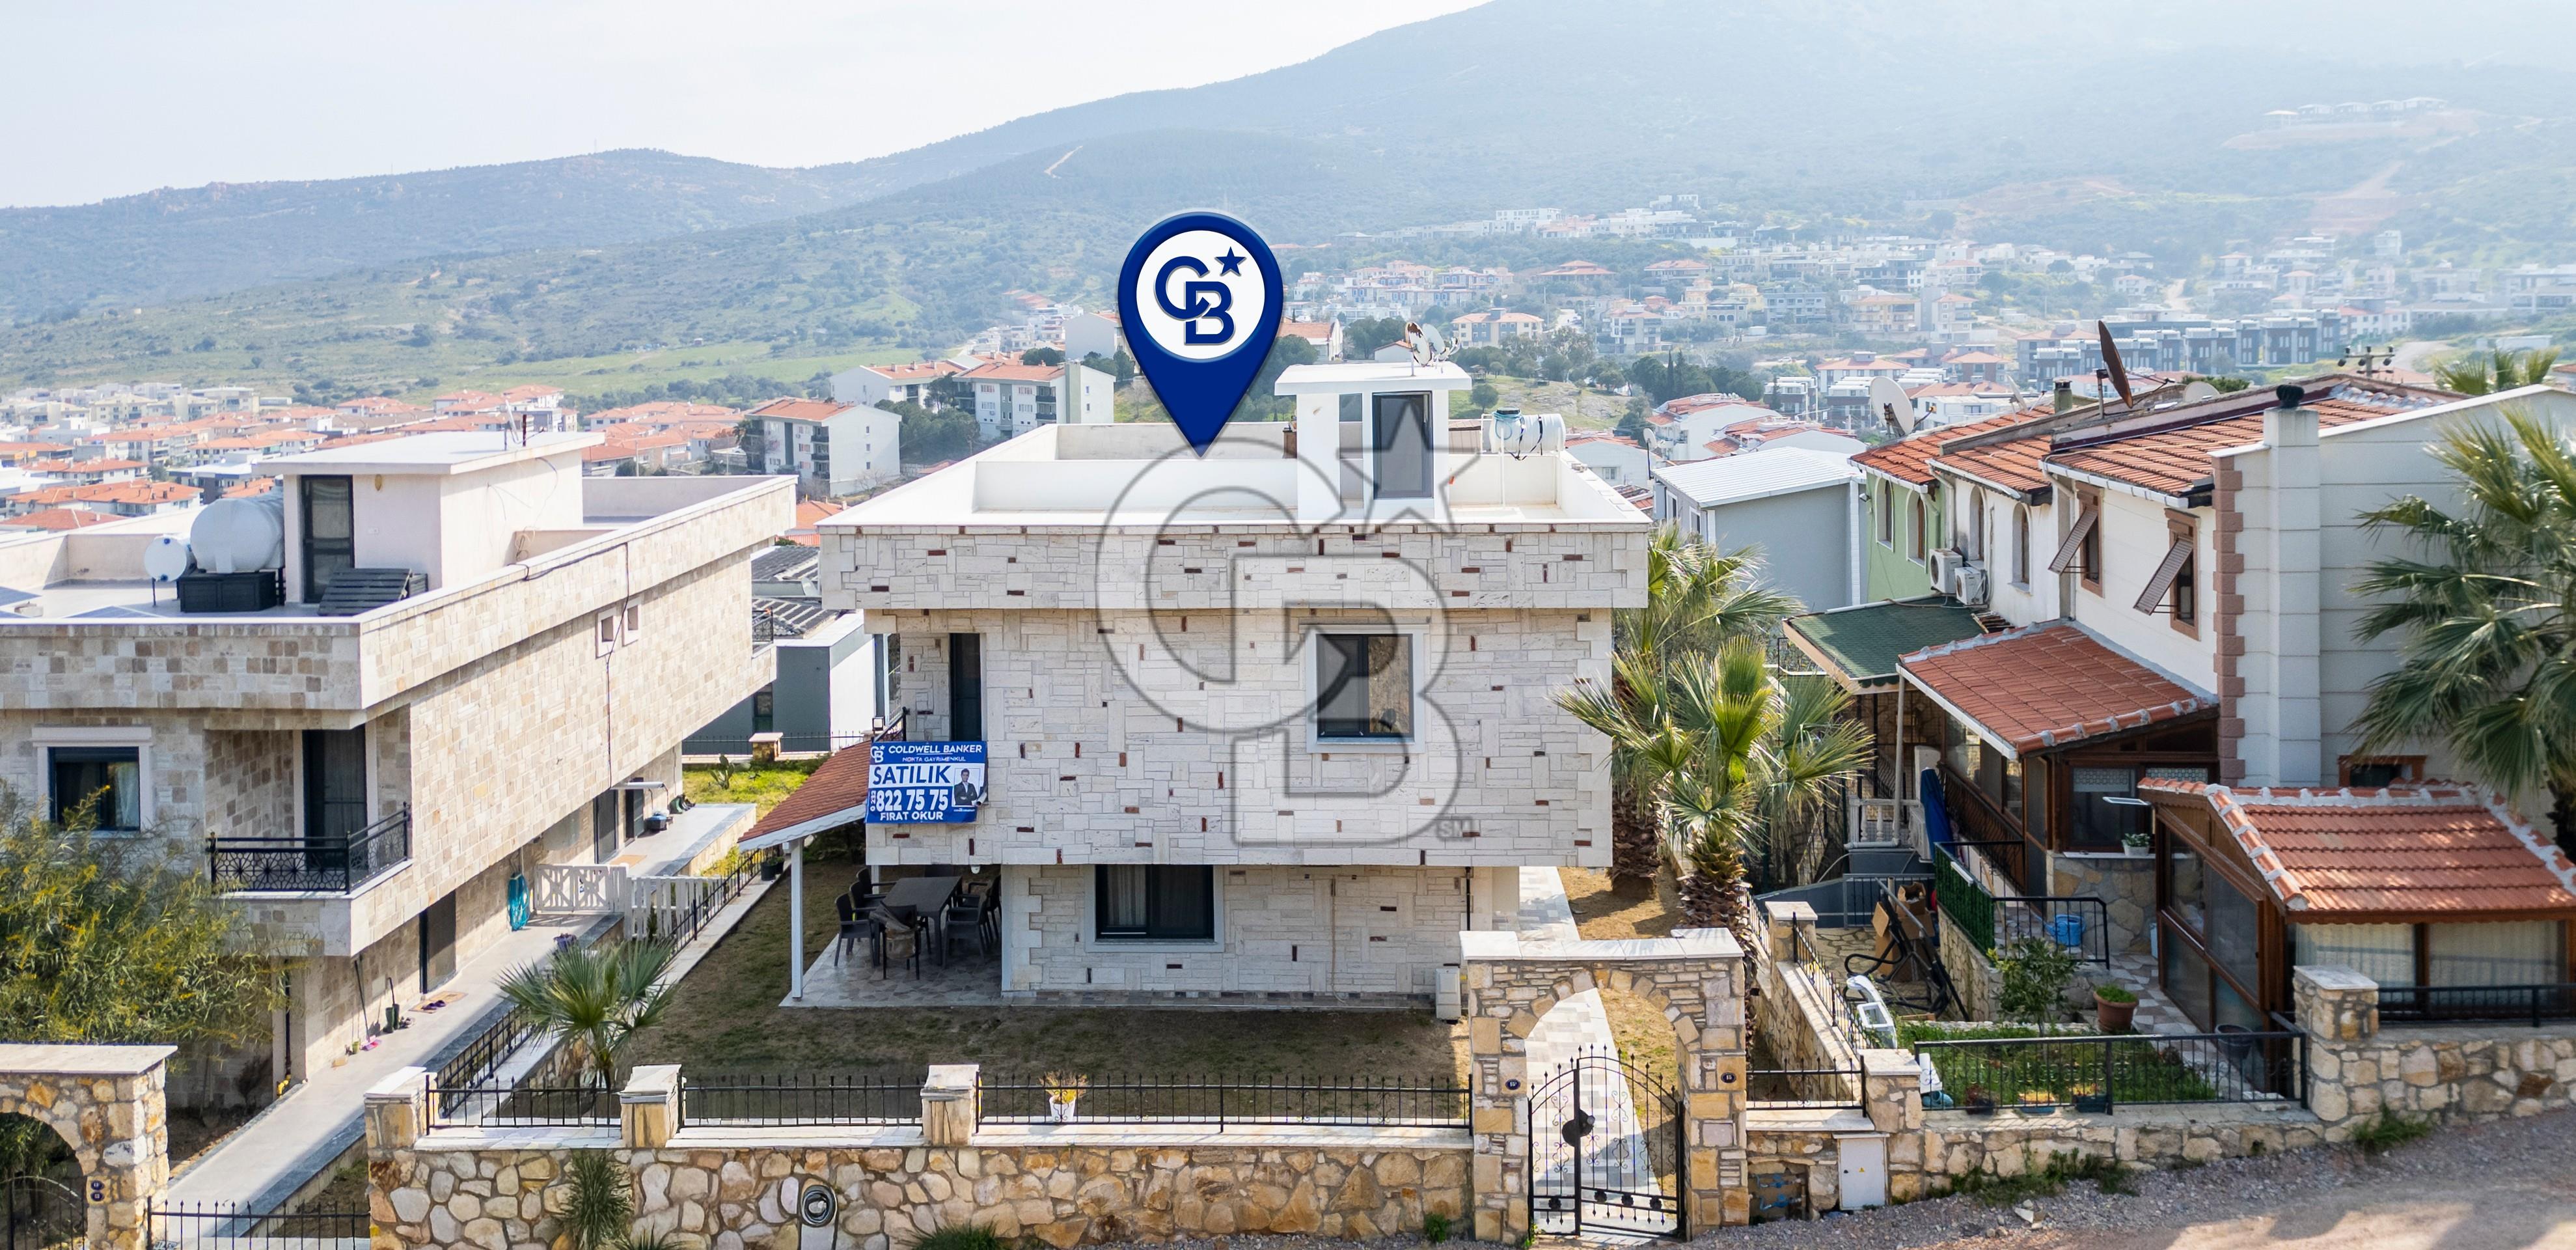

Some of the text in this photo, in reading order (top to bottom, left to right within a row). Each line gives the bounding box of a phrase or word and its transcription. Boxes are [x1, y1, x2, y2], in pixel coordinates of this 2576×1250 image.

[888, 744, 982, 754] COLDWELL BANKER
[873, 766, 951, 785] SATILIK
[876, 789, 948, 812] 822 75 75
[880, 811, 944, 821] FIRAT OKUR
